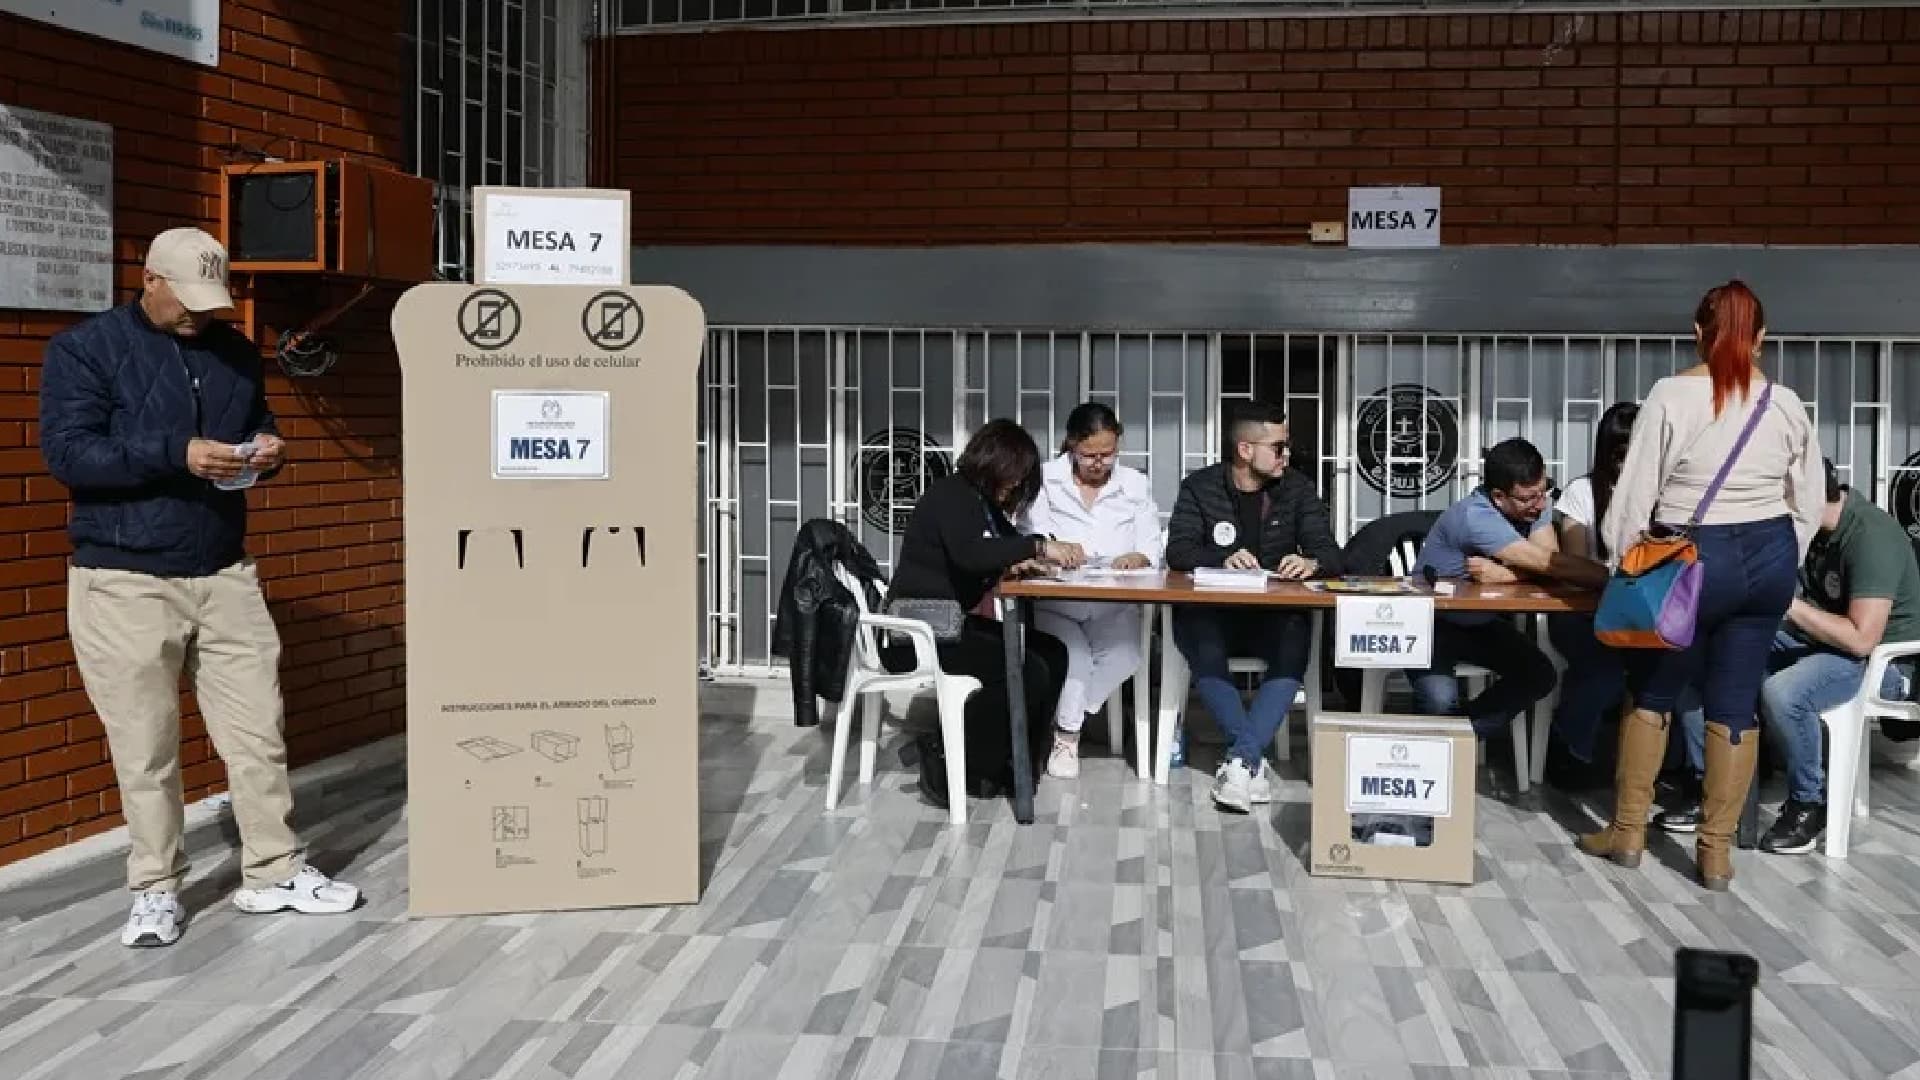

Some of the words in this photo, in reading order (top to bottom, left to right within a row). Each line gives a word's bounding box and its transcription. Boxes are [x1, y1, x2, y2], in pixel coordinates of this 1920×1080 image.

[1351, 210, 1417, 230] MESA
[1424, 208, 1438, 230] 7
[506, 229, 576, 251] MESA
[589, 232, 603, 251] 7
[455, 353, 525, 368] Prohibido
[529, 354, 543, 368] el
[546, 357, 570, 368] uso
[574, 354, 589, 368] de
[593, 354, 641, 368] celular
[510, 437, 572, 460] MESA
[576, 439, 591, 460] 7
[1350, 634, 1402, 654] MESA
[1405, 635, 1418, 654] 7
[514, 702, 538, 711] PARA
[1361, 775, 1417, 799] MESA
[1422, 779, 1436, 800] 7
